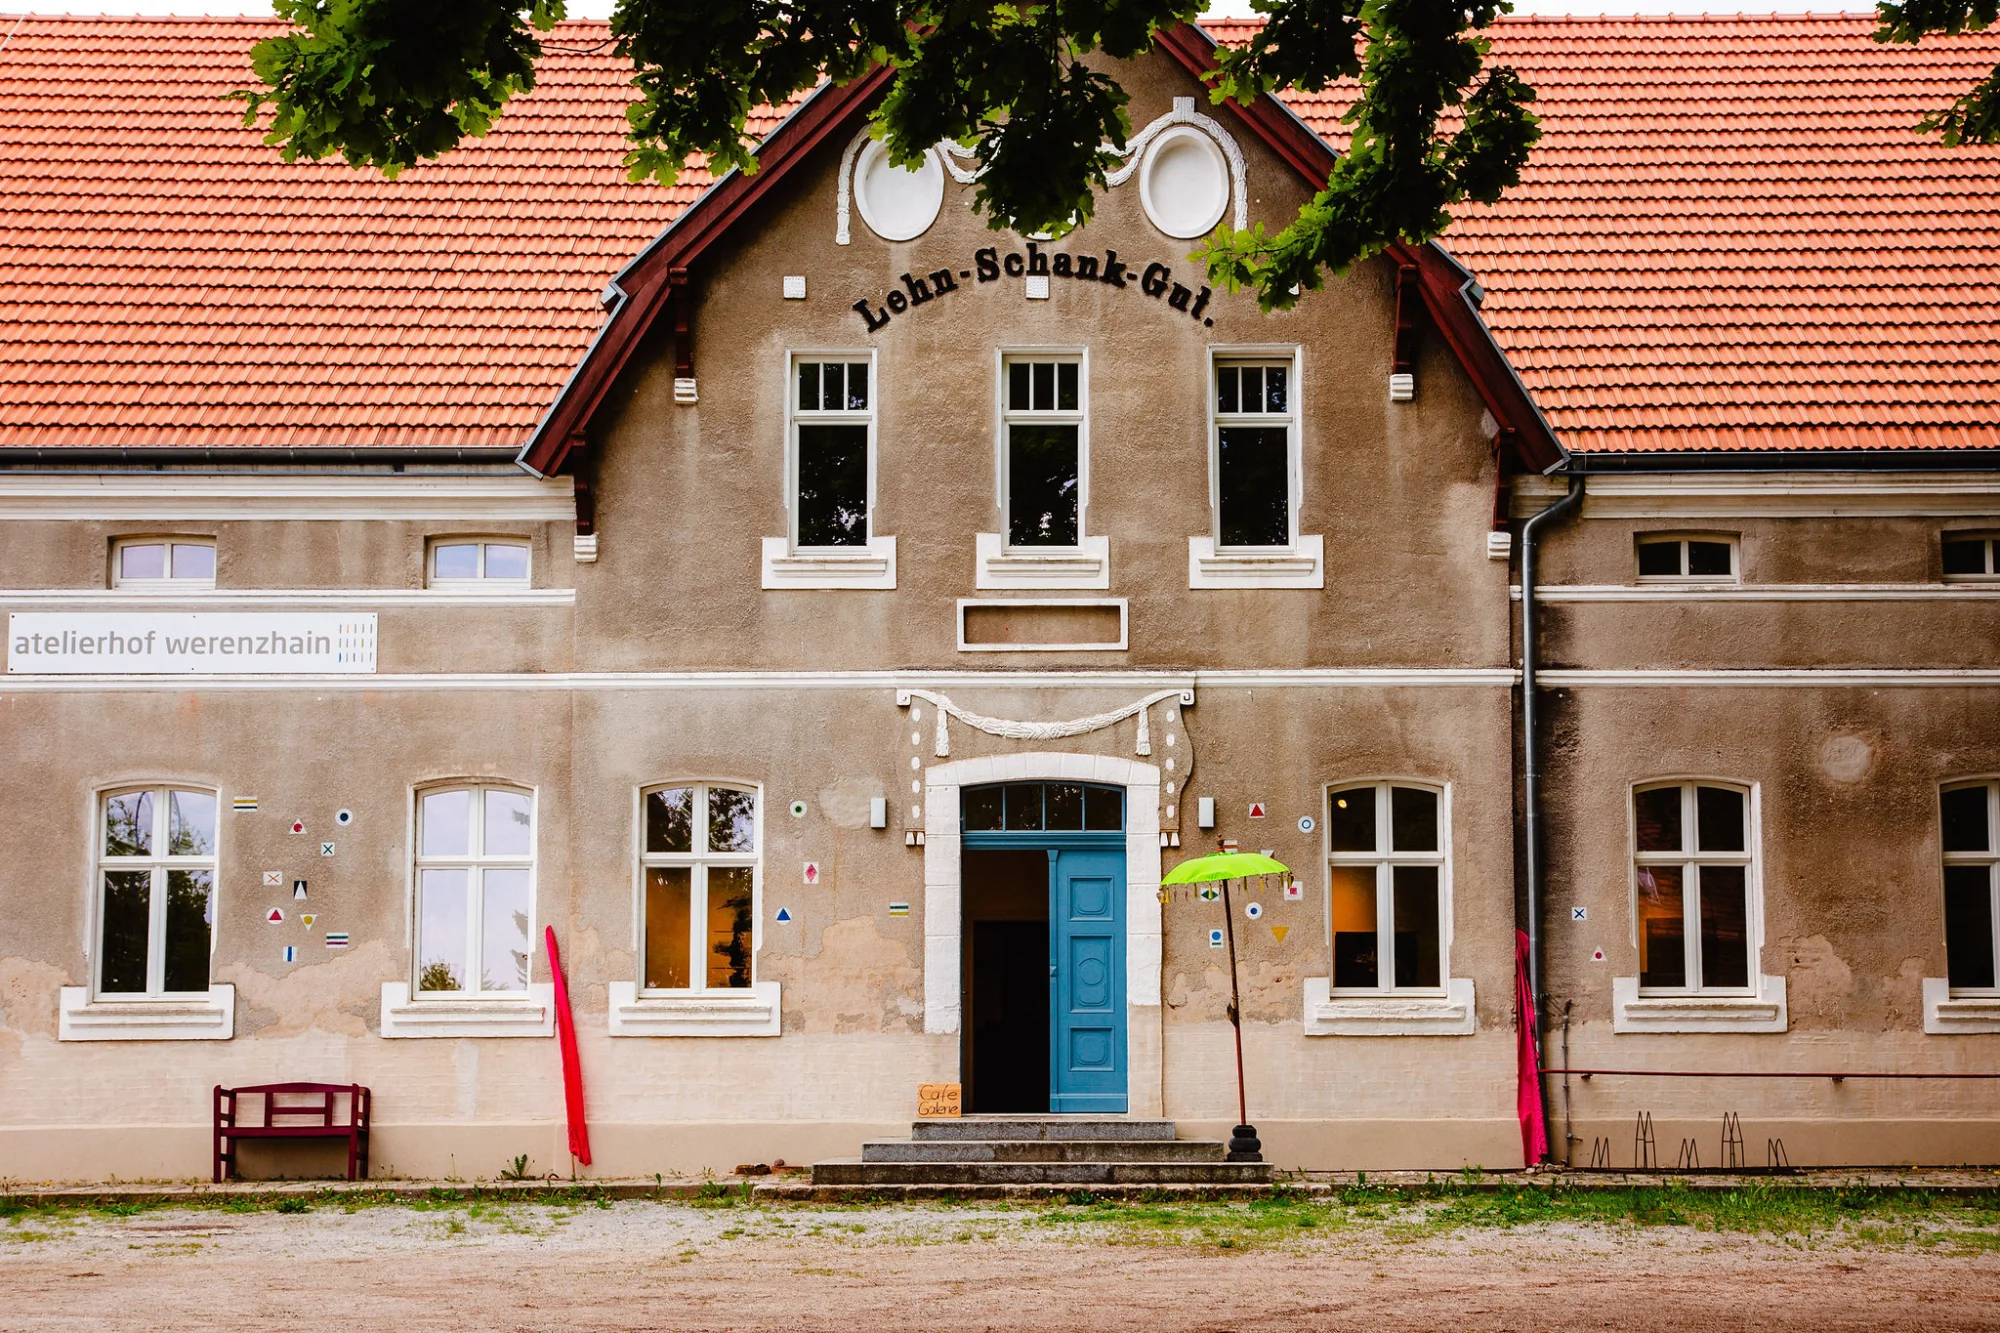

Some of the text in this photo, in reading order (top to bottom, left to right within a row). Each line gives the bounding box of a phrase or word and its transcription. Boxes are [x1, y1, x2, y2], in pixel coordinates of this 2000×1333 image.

[15, 631, 331, 655] atelierhof werenzhain
[920, 1084, 958, 1102] Cafe
